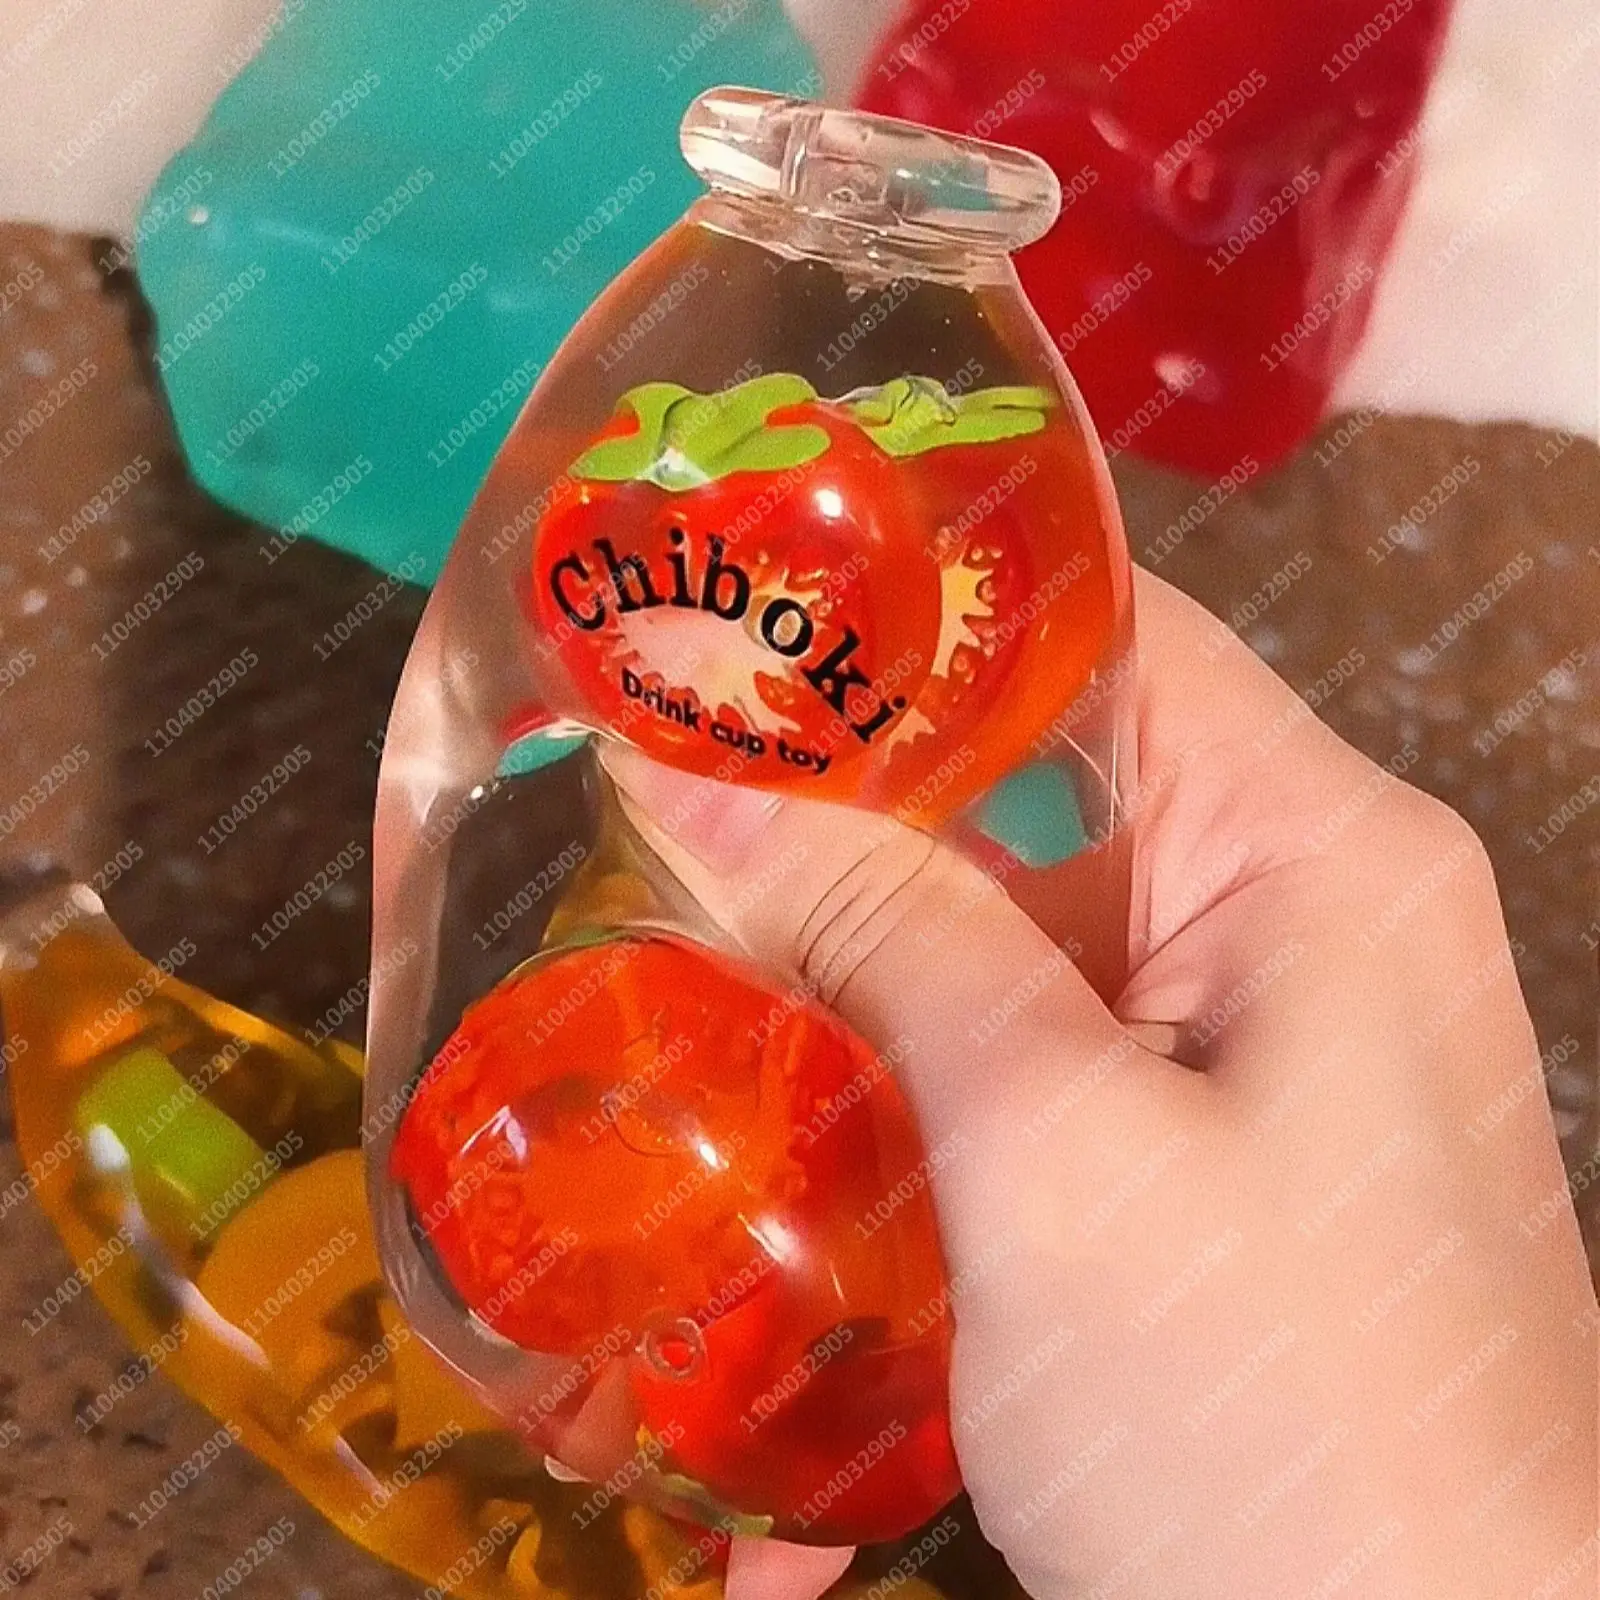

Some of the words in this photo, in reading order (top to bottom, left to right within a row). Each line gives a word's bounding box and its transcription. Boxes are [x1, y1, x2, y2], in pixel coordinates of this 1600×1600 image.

[550, 527, 907, 743] Chiboki
[622, 667, 700, 733] Drink
[710, 721, 766, 758] cup
[777, 738, 832, 774] toy
